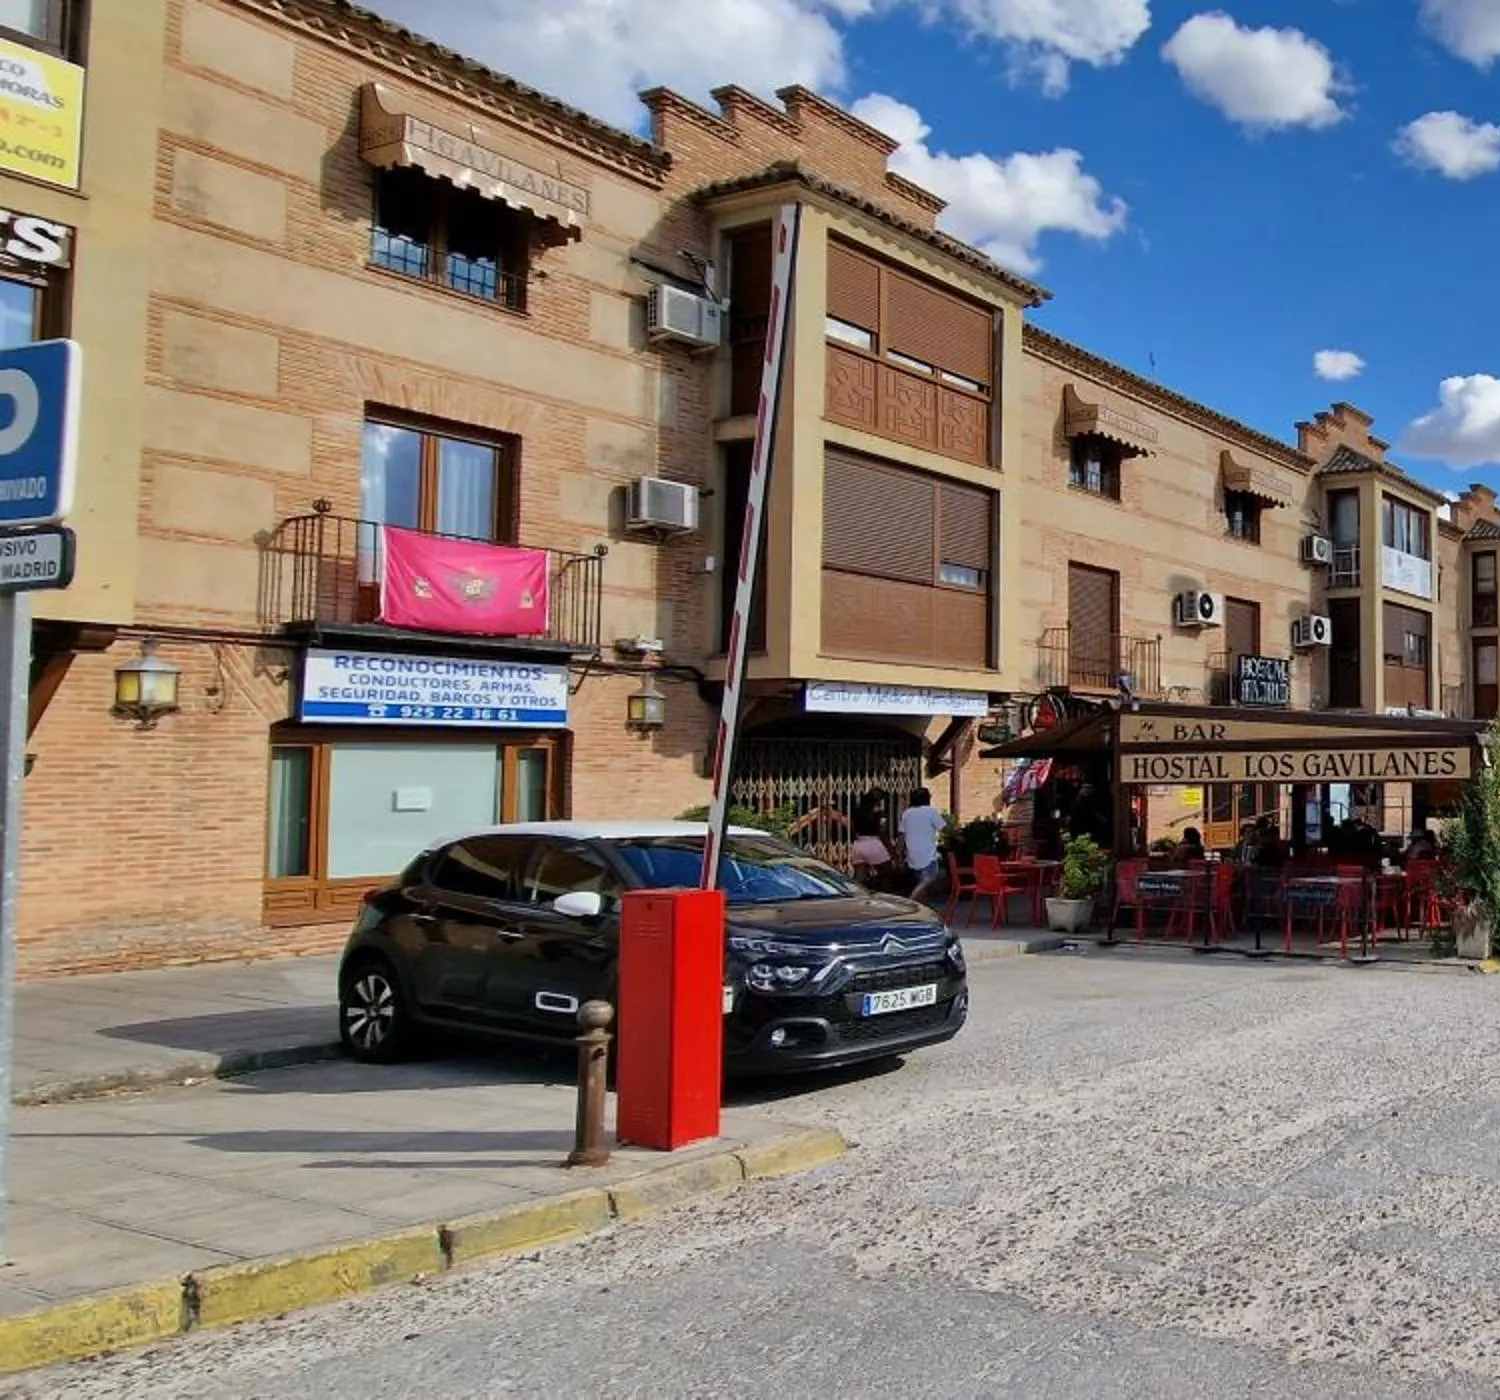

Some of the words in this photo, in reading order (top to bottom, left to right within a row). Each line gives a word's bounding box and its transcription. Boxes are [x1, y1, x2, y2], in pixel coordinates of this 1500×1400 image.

[2, 561, 57, 578] MADRID
[431, 691, 491, 705] BARCOS
[498, 695, 505, 703] Y
[511, 696, 558, 707] OTROS
[400, 704, 434, 719] 925
[442, 707, 464, 720] 22
[498, 709, 519, 721] 61
[1173, 724, 1226, 740] BAR
[1132, 757, 1229, 778] HOSTAL
[1244, 755, 1293, 777] LOS
[1303, 751, 1457, 777] GAVILANES
